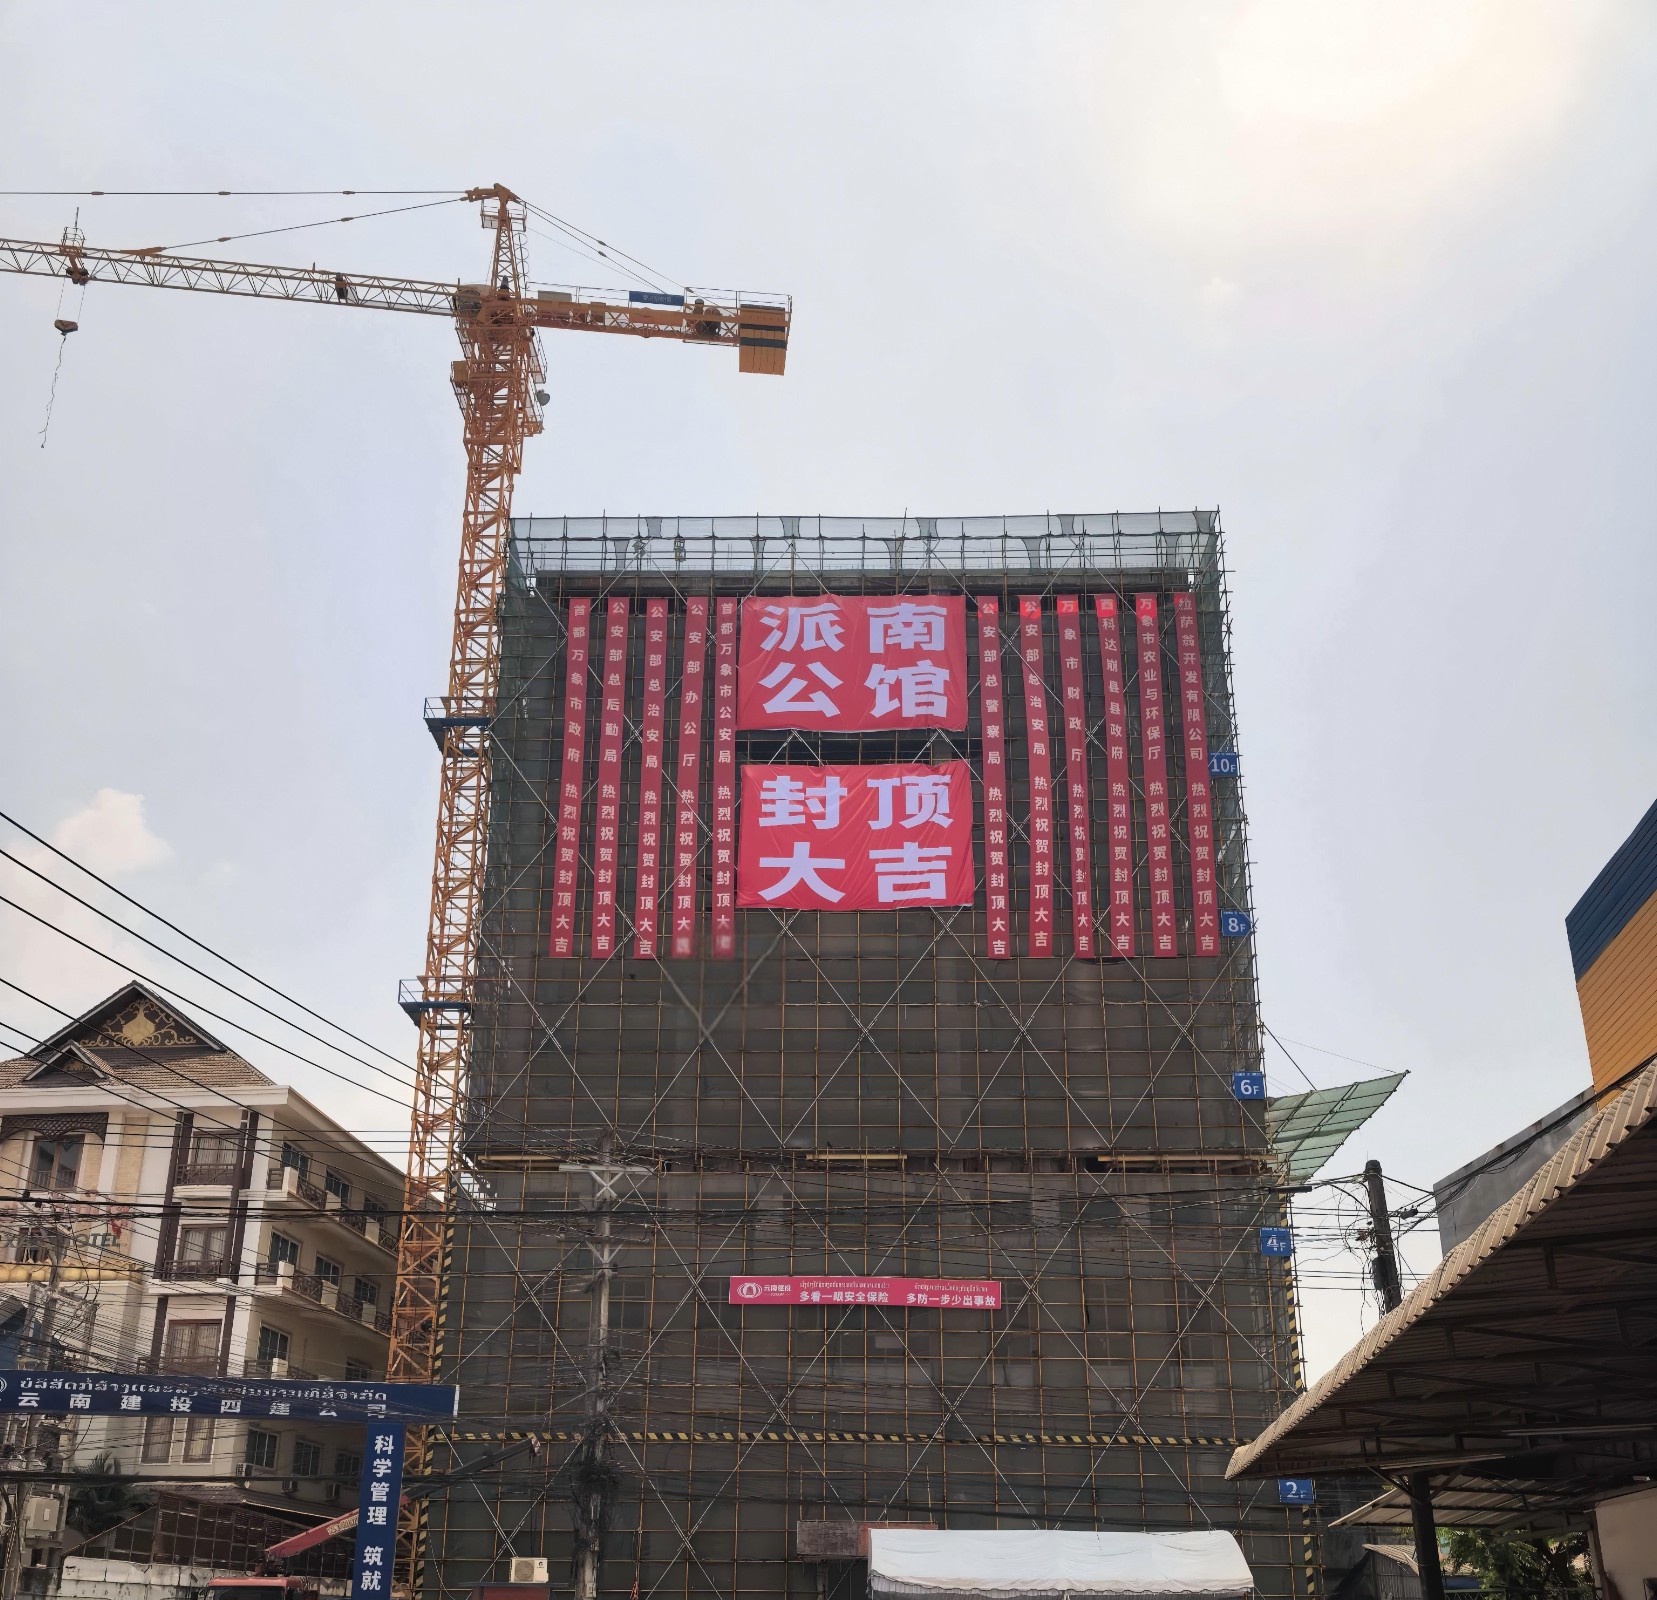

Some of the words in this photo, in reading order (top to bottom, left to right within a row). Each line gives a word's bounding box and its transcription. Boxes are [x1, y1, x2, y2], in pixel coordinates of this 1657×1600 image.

[758, 660, 950, 718] 公馆
[759, 602, 948, 654] 派南
[758, 774, 954, 830] 封顶
[1211, 758, 1237, 772] 10F
[554, 783, 578, 953] 热烈祝贺封顶大吉
[596, 784, 617, 950] 热烈祝贺封顶大吉
[639, 790, 657, 955] 热烈祝贺封顶大吉
[675, 789, 695, 954] 热烈祝贺封顶大
[716, 785, 732, 950] 热烈祝贺封顶大
[757, 841, 953, 904] 大吉
[988, 787, 1006, 955] 热烈祝贺封顶大吉
[1033, 776, 1050, 947] 热烈祝贺封顶大吉
[1112, 782, 1131, 951] 热烈祝贺封顶大吉
[1149, 781, 1172, 950] 热烈祝贺封顶大吉
[1191, 782, 1215, 951] 热烈祝贺封顶大吉
[1228, 917, 1246, 932] 8F
[1240, 1079, 1260, 1095] 6F
[366, 1434, 395, 1526] 科学管理
[360, 1545, 384, 1591] 筑就
